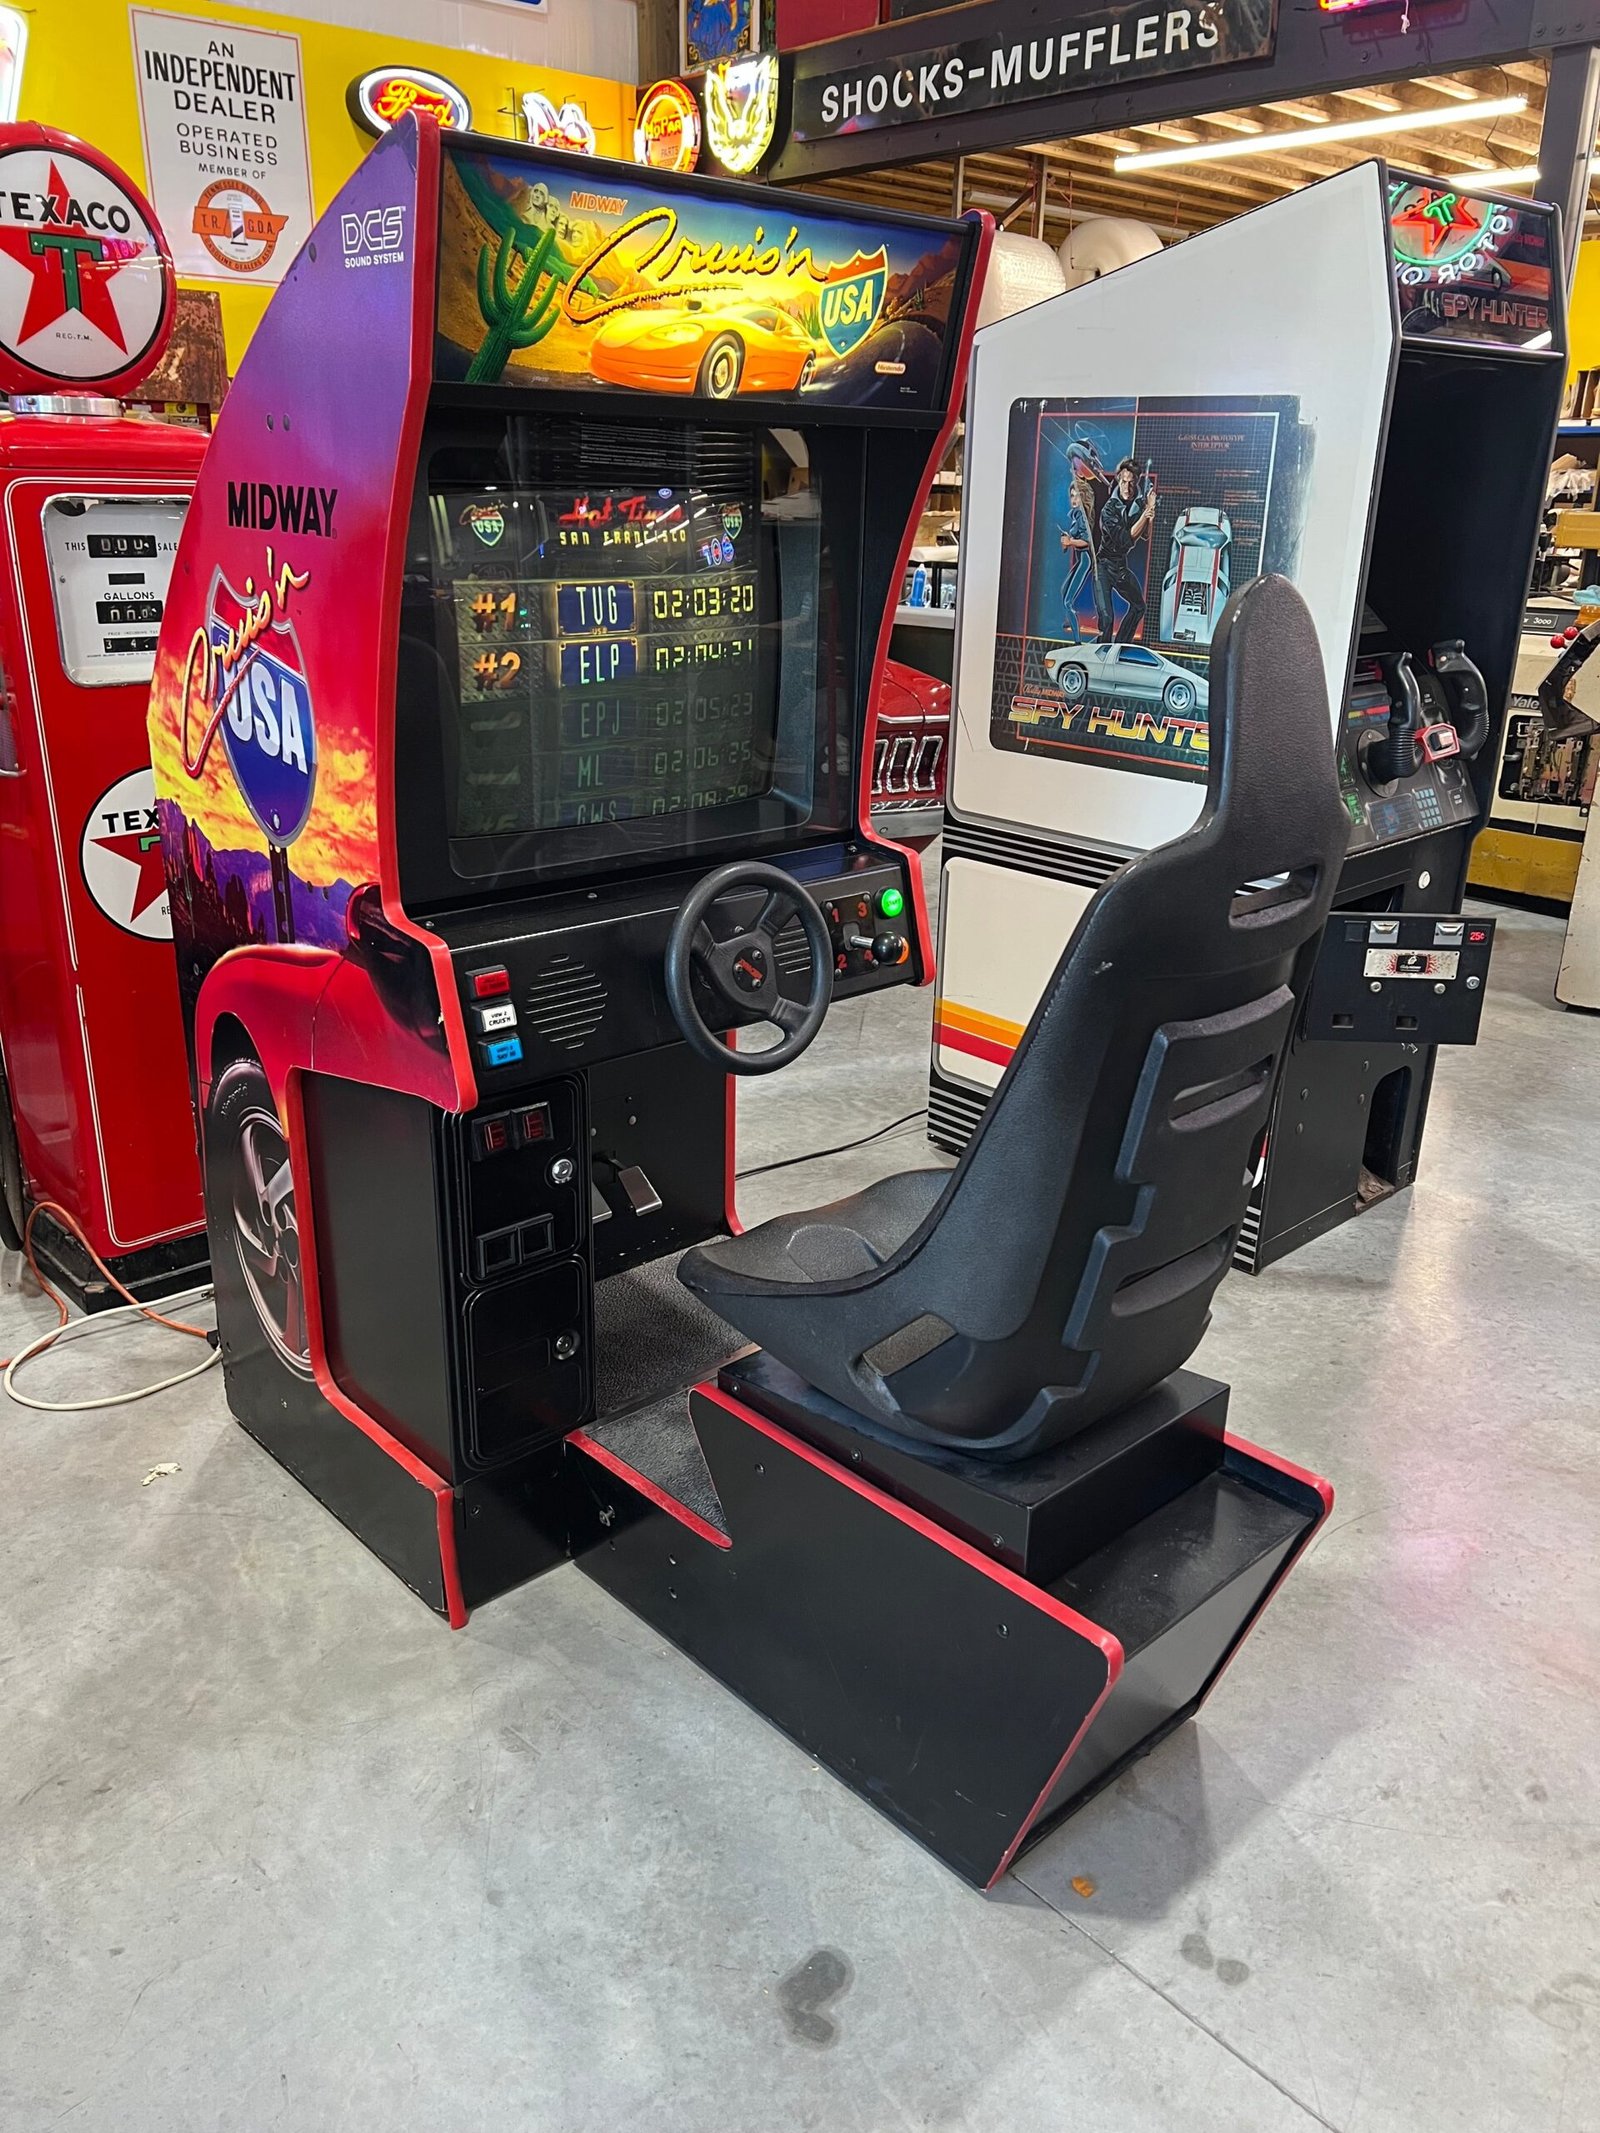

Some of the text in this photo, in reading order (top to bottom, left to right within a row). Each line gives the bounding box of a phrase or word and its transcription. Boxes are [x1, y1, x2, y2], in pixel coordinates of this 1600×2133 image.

[208, 40, 234, 58] AN
[821, 2, 1223, 122] SHOCKS-MUFFLERS
[144, 49, 296, 102] INDEPENDENT
[173, 89, 276, 124] DEALER
[176, 122, 277, 149] OPERATED
[180, 140, 278, 166] BUSINESS
[198, 162, 267, 180] MEMBER OF
[570, 191, 628, 216] MIDWAY
[341, 206, 403, 254] DCS
[345, 251, 404, 269] SOUND SYSTEM
[563, 206, 829, 325] Cruis'n
[823, 278, 875, 328] USA
[1441, 292, 1549, 329] SPY HUNTER
[227, 481, 338, 538] MIDWAY
[618, 495, 686, 524] Tims
[475, 519, 500, 533] USA
[559, 531, 590, 545] SAN
[65, 542, 86, 551] THIS
[158, 542, 178, 551] SALE
[104, 592, 155, 600] GALLONS
[471, 585, 754, 632] #1 TUG 02:03:20
[1532, 617, 1552, 625] 3000
[181, 545, 310, 778] Cruis'n
[473, 651, 522, 690] #2
[580, 643, 620, 685] ELP
[222, 652, 308, 775] USA
[1008, 695, 1084, 730] SPY
[1512, 696, 1539, 710] Yale
[832, 908, 840, 923] 1
[857, 902, 868, 918] 3
[837, 953, 848, 969] 2
